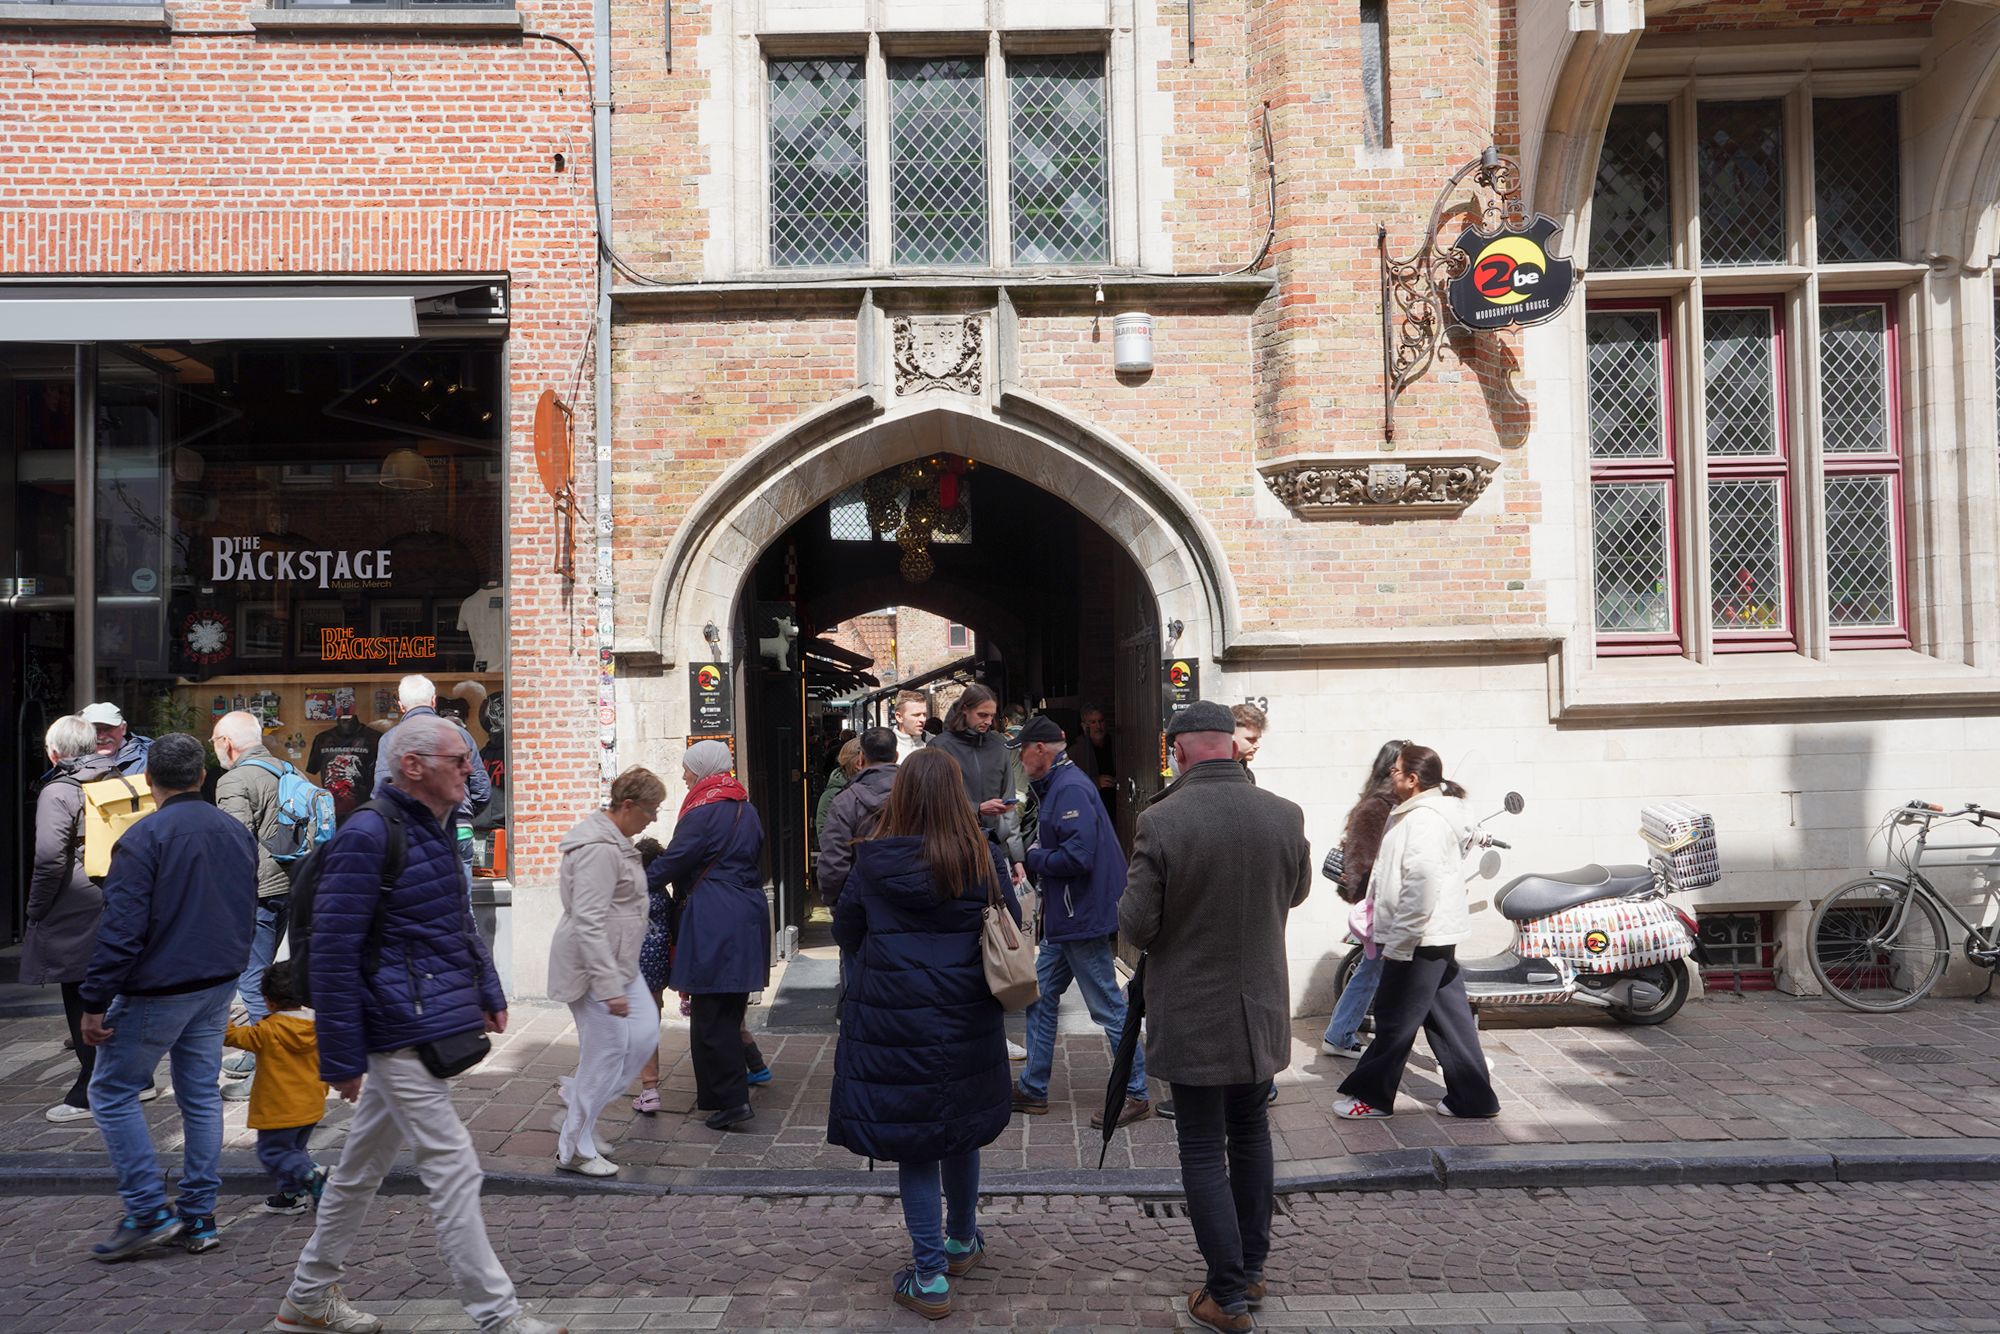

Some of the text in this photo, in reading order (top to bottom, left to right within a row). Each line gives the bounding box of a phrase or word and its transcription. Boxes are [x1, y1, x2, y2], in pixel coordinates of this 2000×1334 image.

[1526, 299, 1550, 312] BRUGGE
[233, 536, 260, 554] THE
[211, 536, 392, 589] BACKSTAGE
[331, 580, 392, 589] Music Merch
[336, 628, 355, 641] THE
[321, 627, 436, 665] BACKSTAGE
[1245, 697, 1268, 714] 53
